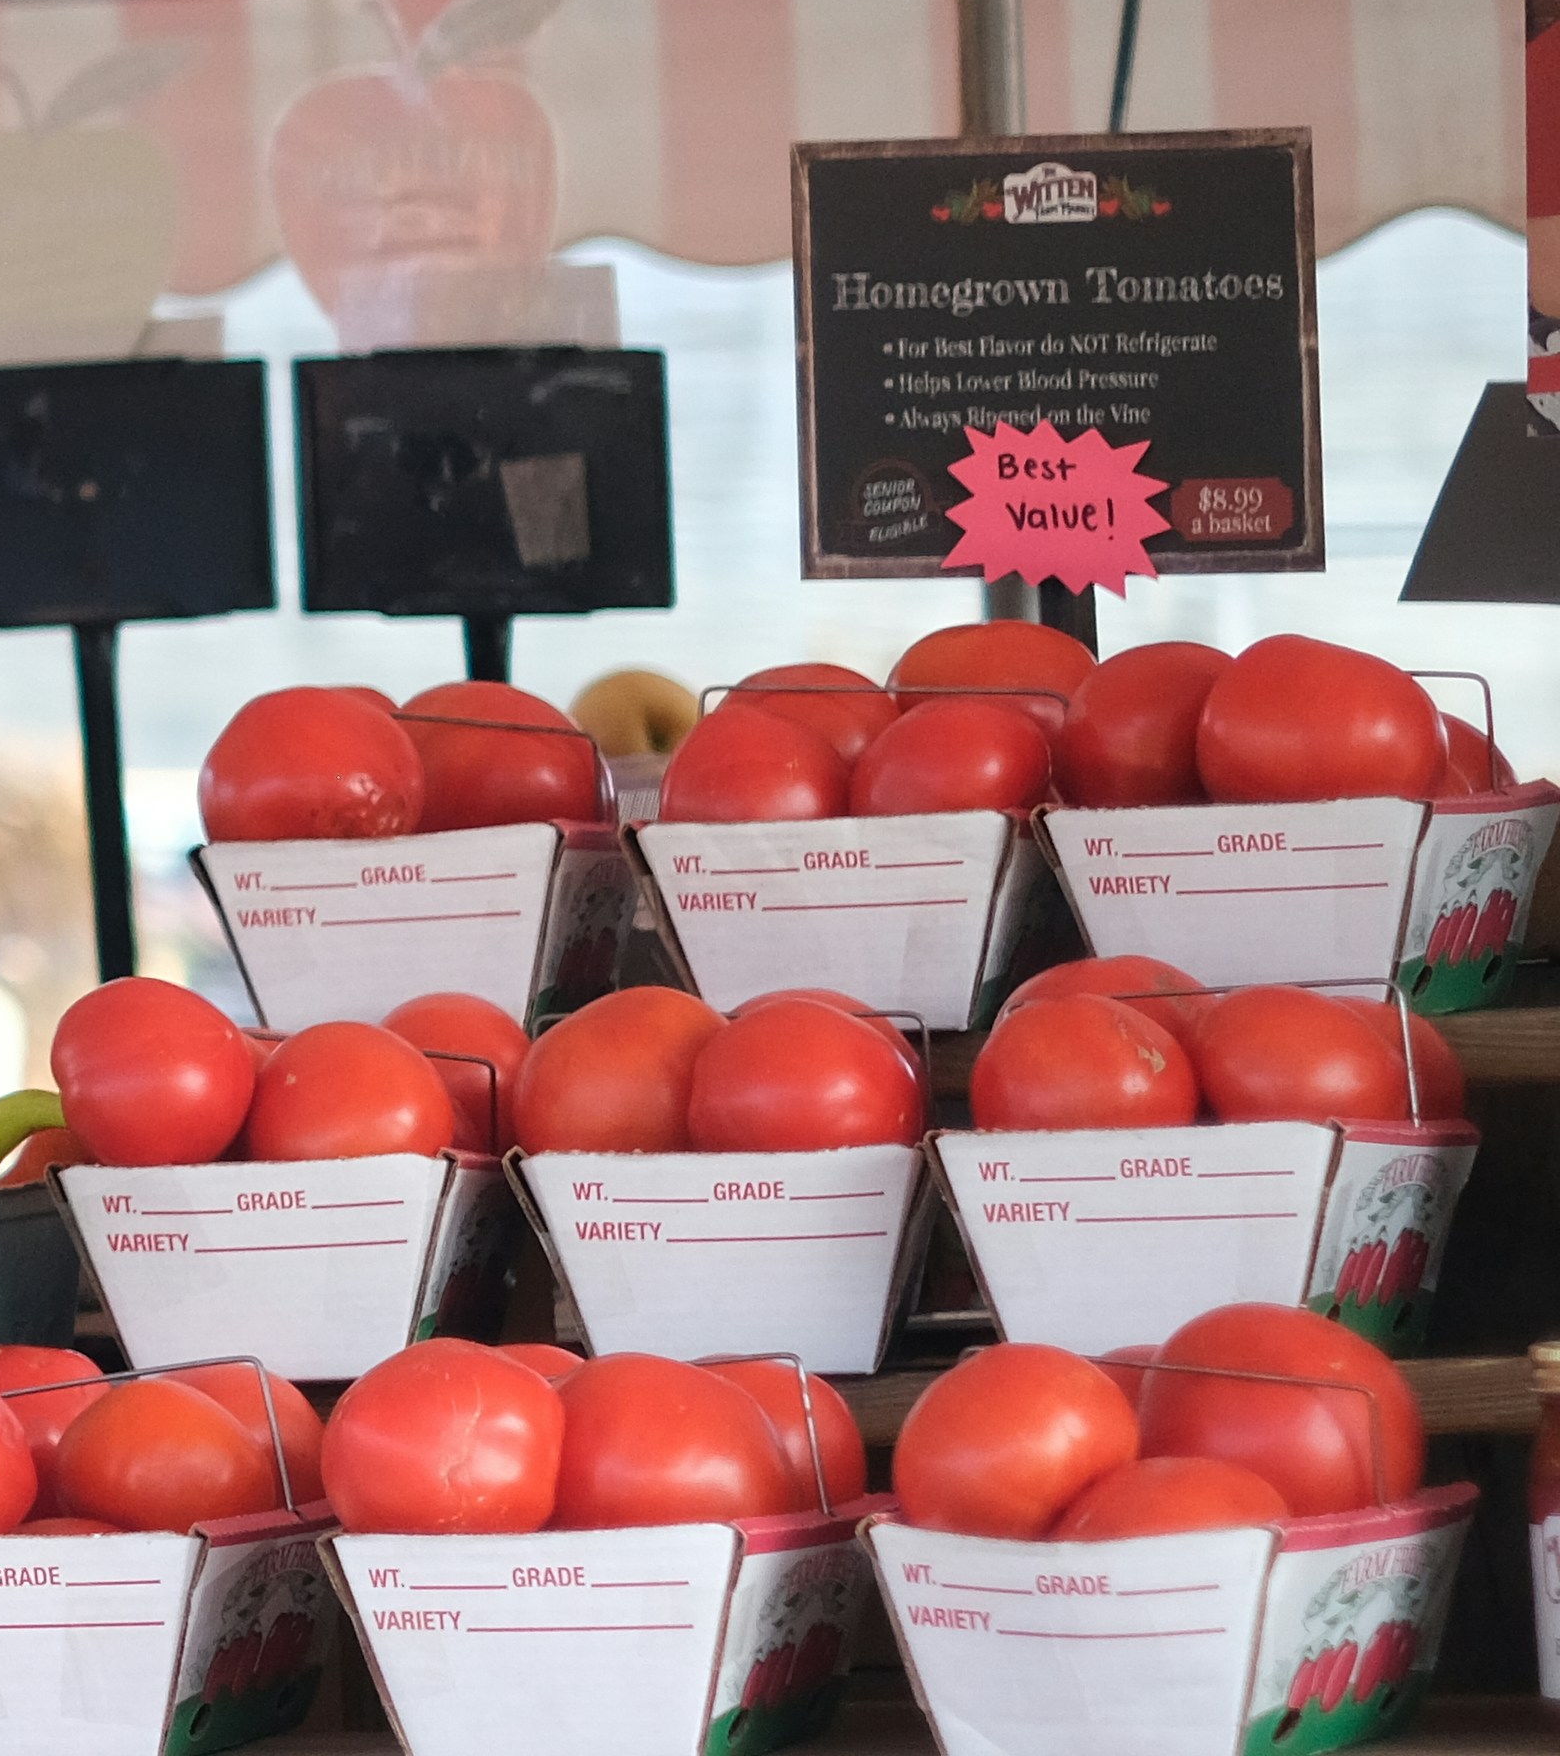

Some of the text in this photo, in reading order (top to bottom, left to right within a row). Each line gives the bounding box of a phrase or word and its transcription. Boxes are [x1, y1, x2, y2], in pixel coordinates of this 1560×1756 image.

[1005, 178, 1095, 221] WITTEN
[832, 264, 1284, 318] Homegrown Tomatoes
[899, 330, 1218, 359] For Best Flavor do NOT Refrigerate
[899, 367, 1159, 398] Helps Lower Blood Pressure
[900, 402, 1151, 434] Always Ripened on the Vine
[997, 453, 1077, 483] Best
[863, 494, 922, 517] COUPON
[1196, 484, 1264, 516] $8.99
[1004, 497, 1116, 542] Value!
[1191, 510, 1273, 538] a basket
[1084, 831, 1287, 859] WT. GRADE
[672, 849, 871, 876] WT. GRADE
[234, 864, 426, 892] WT. GRADE
[1088, 874, 1172, 896] VARIETY
[677, 891, 758, 913] VARIETY
[237, 906, 317, 930] VARIETY
[978, 1156, 1193, 1184] WT. GRADE
[102, 1189, 307, 1216] WT. GRADE
[573, 1179, 785, 1204] WT. GRADE
[983, 1199, 1071, 1224] VARIETY
[106, 1232, 190, 1255] VARIETY
[575, 1220, 663, 1244] VARIETY
[368, 1565, 586, 1590] WT. GRADE
[902, 1561, 1112, 1598] WT. GRADE
[373, 1608, 462, 1633] VARIETY
[906, 1604, 992, 1636] VARIETY
